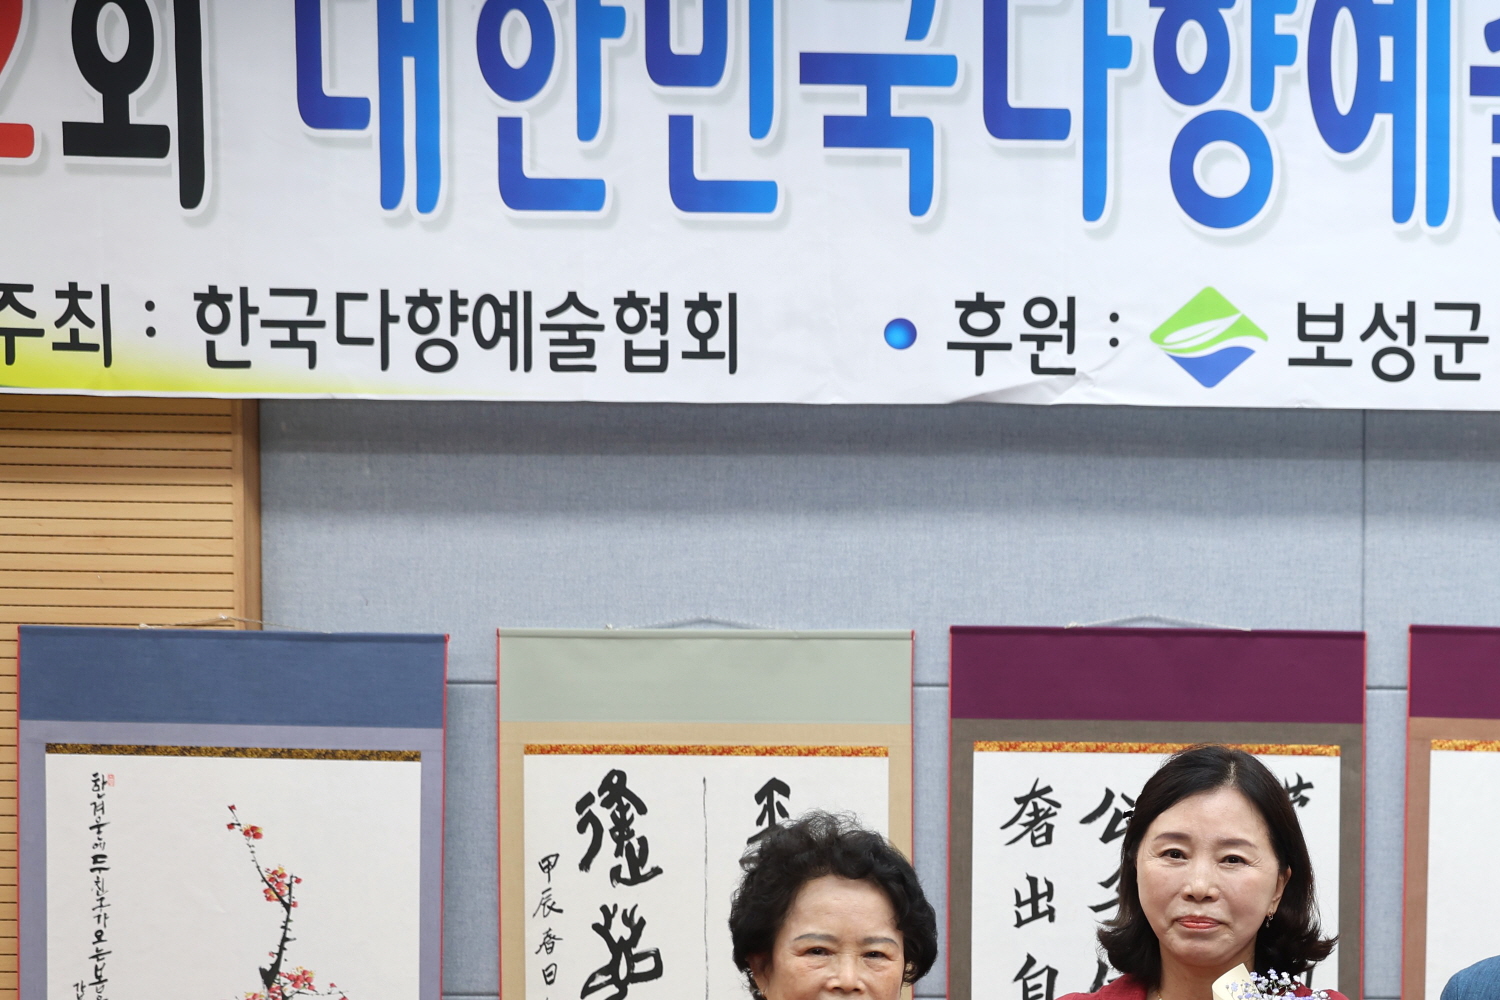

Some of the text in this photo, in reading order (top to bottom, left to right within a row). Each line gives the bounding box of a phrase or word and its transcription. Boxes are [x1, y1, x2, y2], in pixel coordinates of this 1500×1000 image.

[0, 282, 112, 368] 주최
[193, 284, 739, 375] 한국다향예술협회
[947, 292, 1077, 376] 후원
[1288, 301, 1490, 382] 보성군
